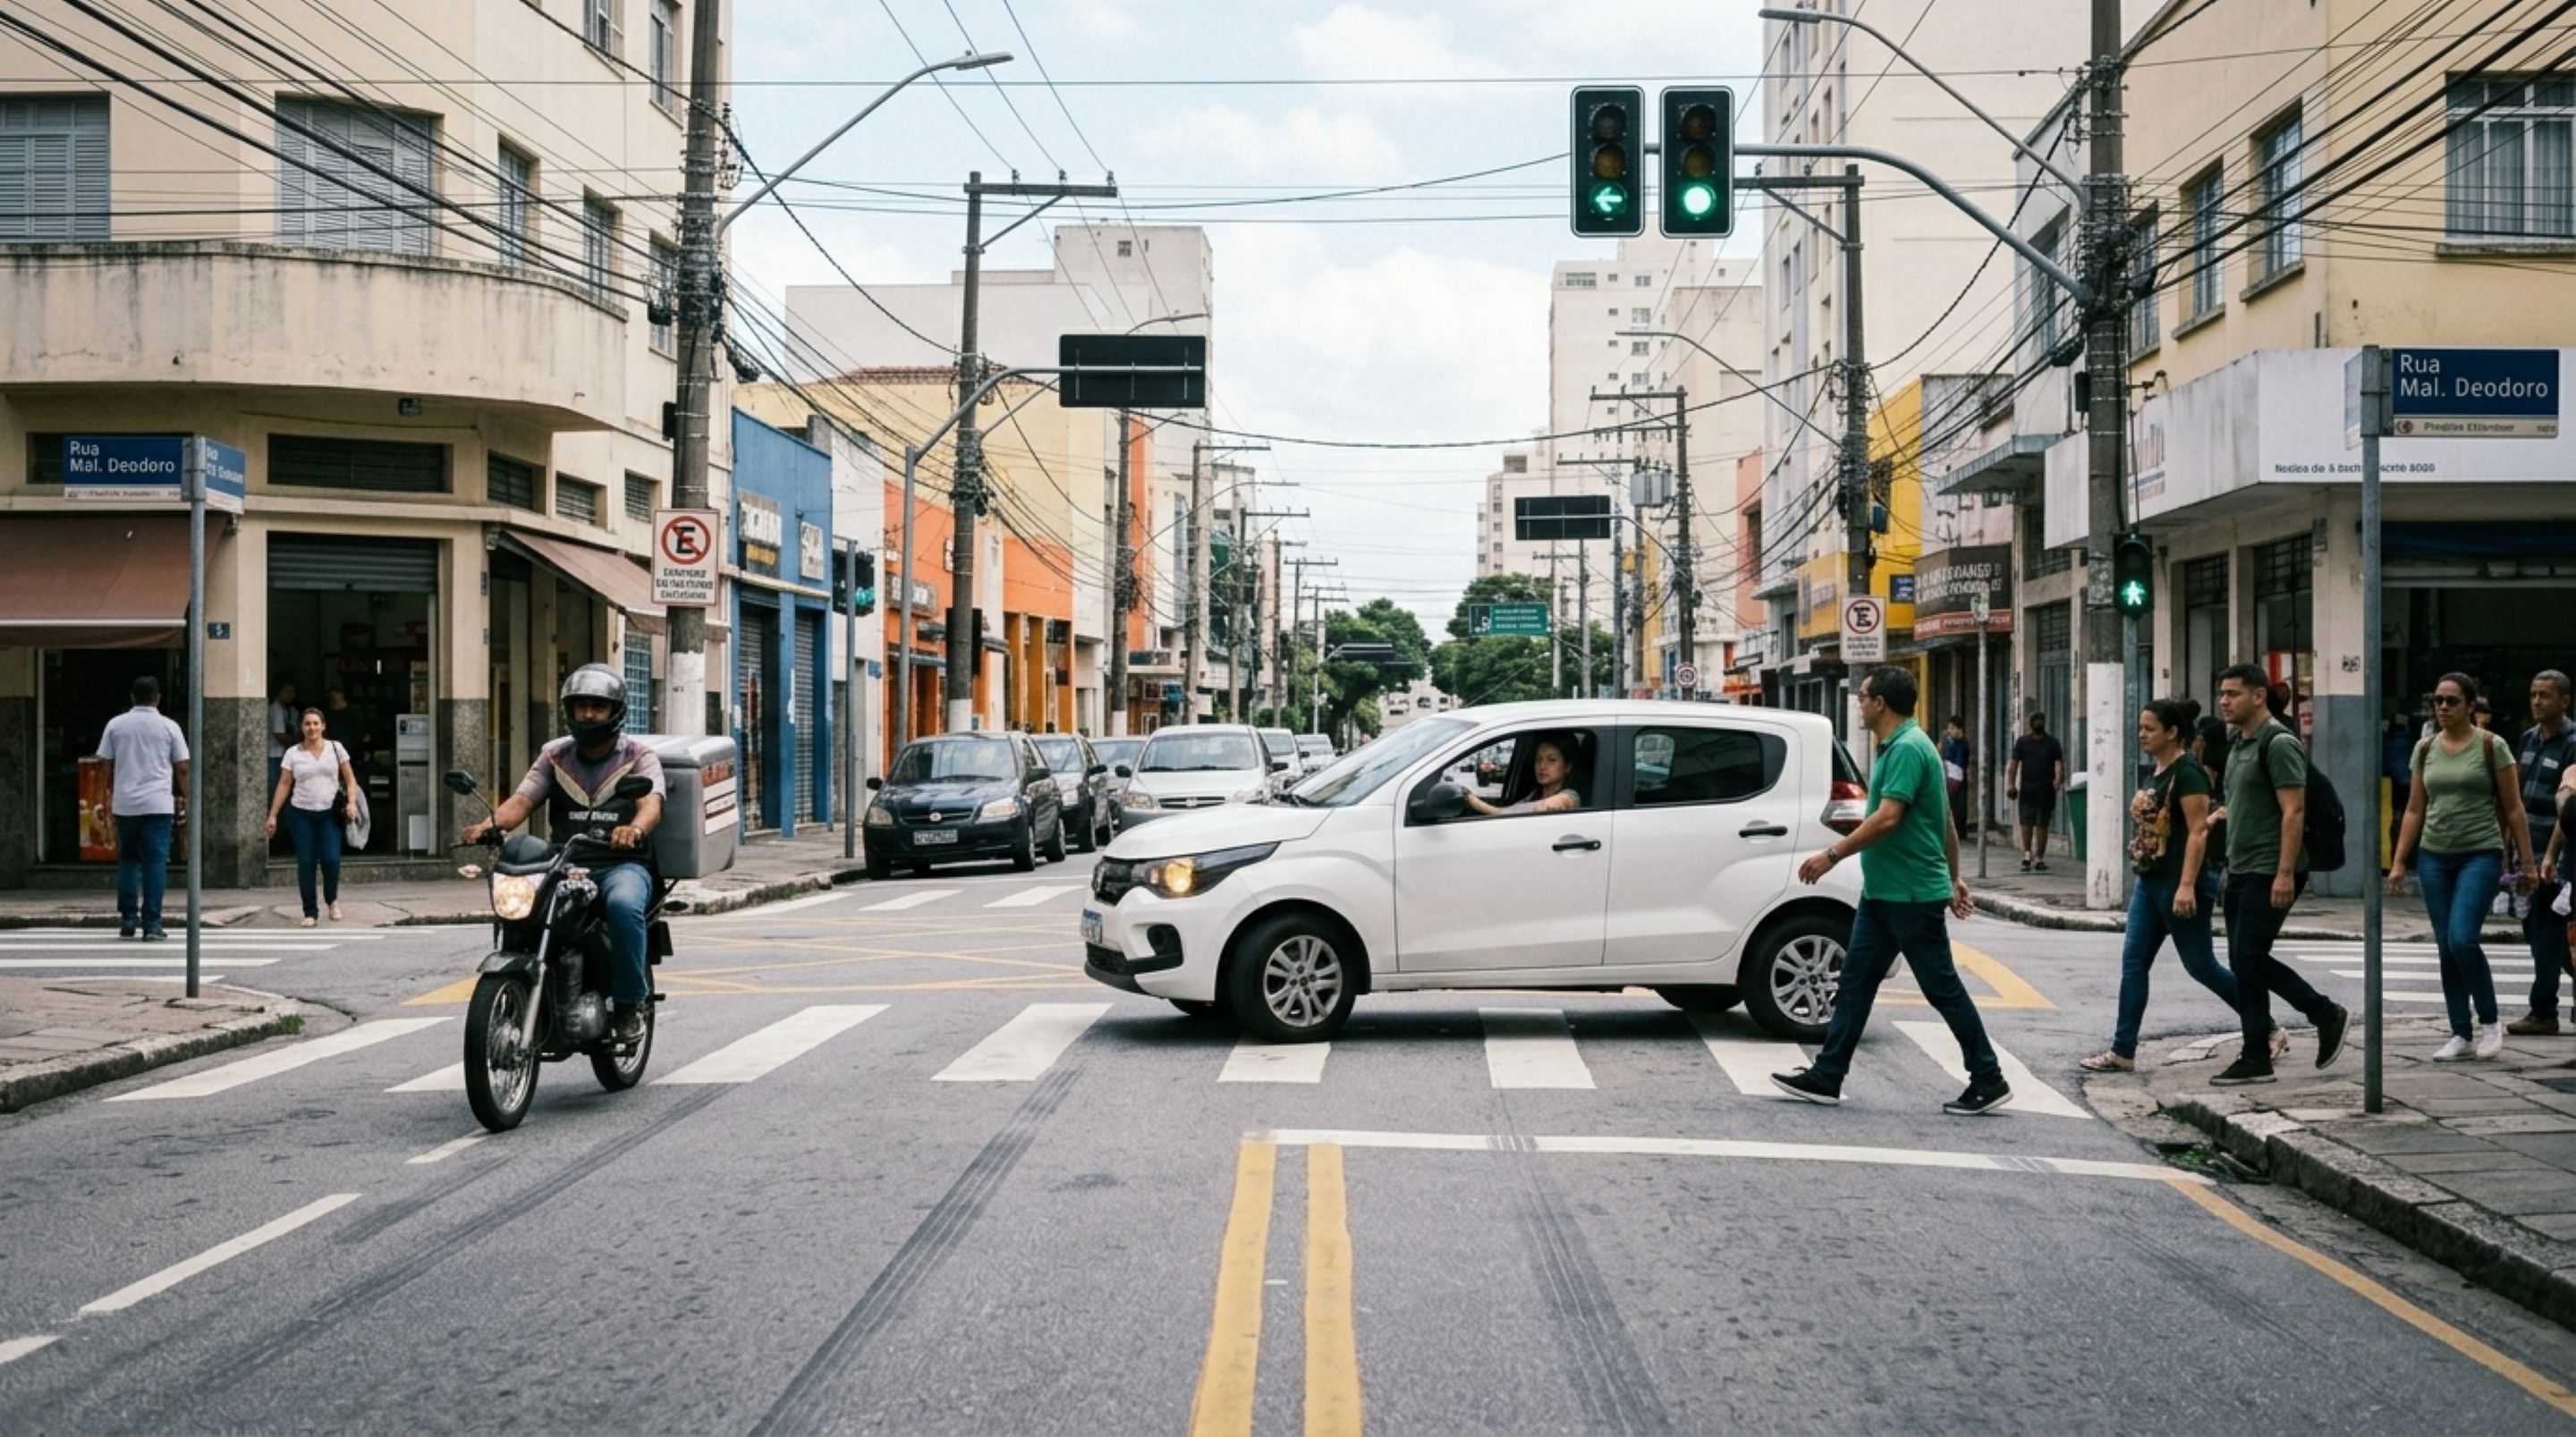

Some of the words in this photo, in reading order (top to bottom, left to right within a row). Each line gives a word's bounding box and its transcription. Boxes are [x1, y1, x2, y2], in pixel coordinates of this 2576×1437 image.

[2400, 354, 2441, 374] Rua
[2400, 376, 2445, 397] Mal.
[2455, 376, 2548, 397] Deodoro
[70, 441, 99, 456] Rua
[70, 458, 103, 472] Mal.
[108, 458, 175, 472] Deodoro
